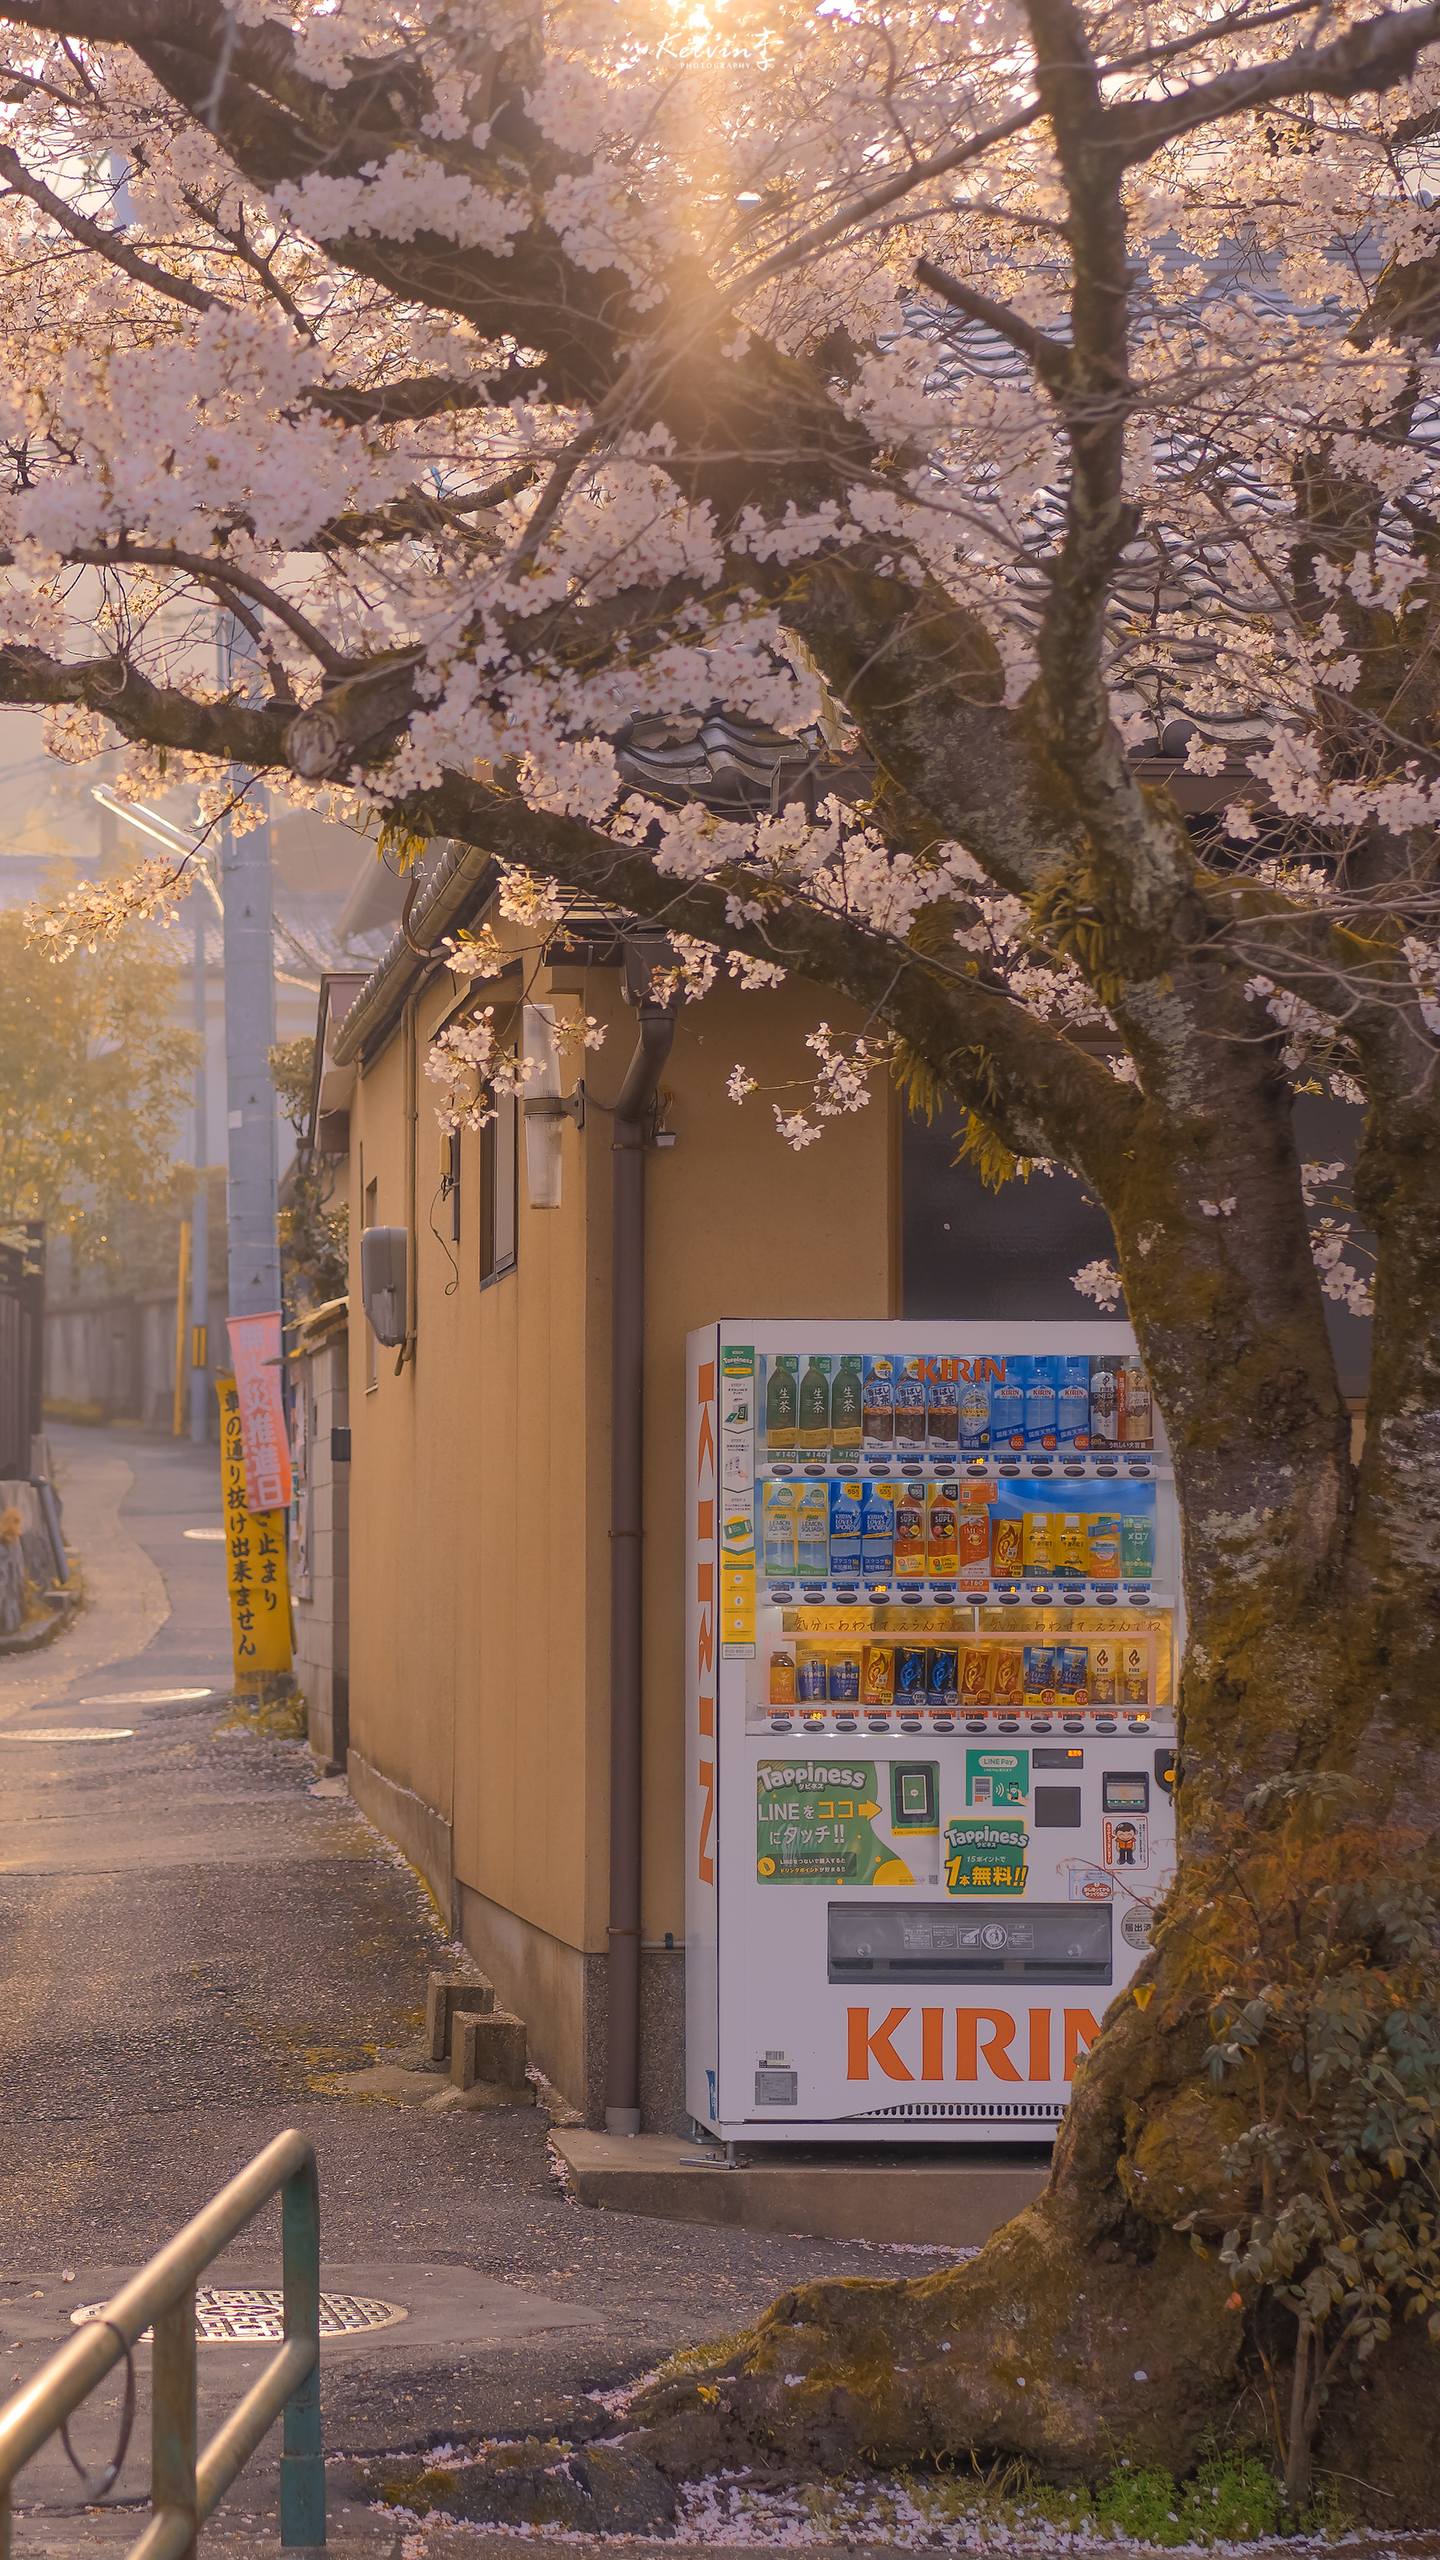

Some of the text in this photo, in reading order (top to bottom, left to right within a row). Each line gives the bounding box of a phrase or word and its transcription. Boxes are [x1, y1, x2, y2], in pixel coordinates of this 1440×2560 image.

[917, 1358, 1007, 1383] KIRIN
[778, 1387, 791, 1414] 生茶
[812, 1388, 825, 1414] 生茶
[842, 1386, 856, 1413] 生茶
[1127, 1532, 1149, 1541] メロン
[697, 1360, 715, 1887] KIRIN
[1000, 1758, 1014, 1766] Pay
[758, 1762, 866, 1790] Tappiness
[798, 1783, 825, 1791] タピネス
[945, 1826, 1029, 1847] Tappiness
[946, 1856, 1029, 1888] 1本無料!!
